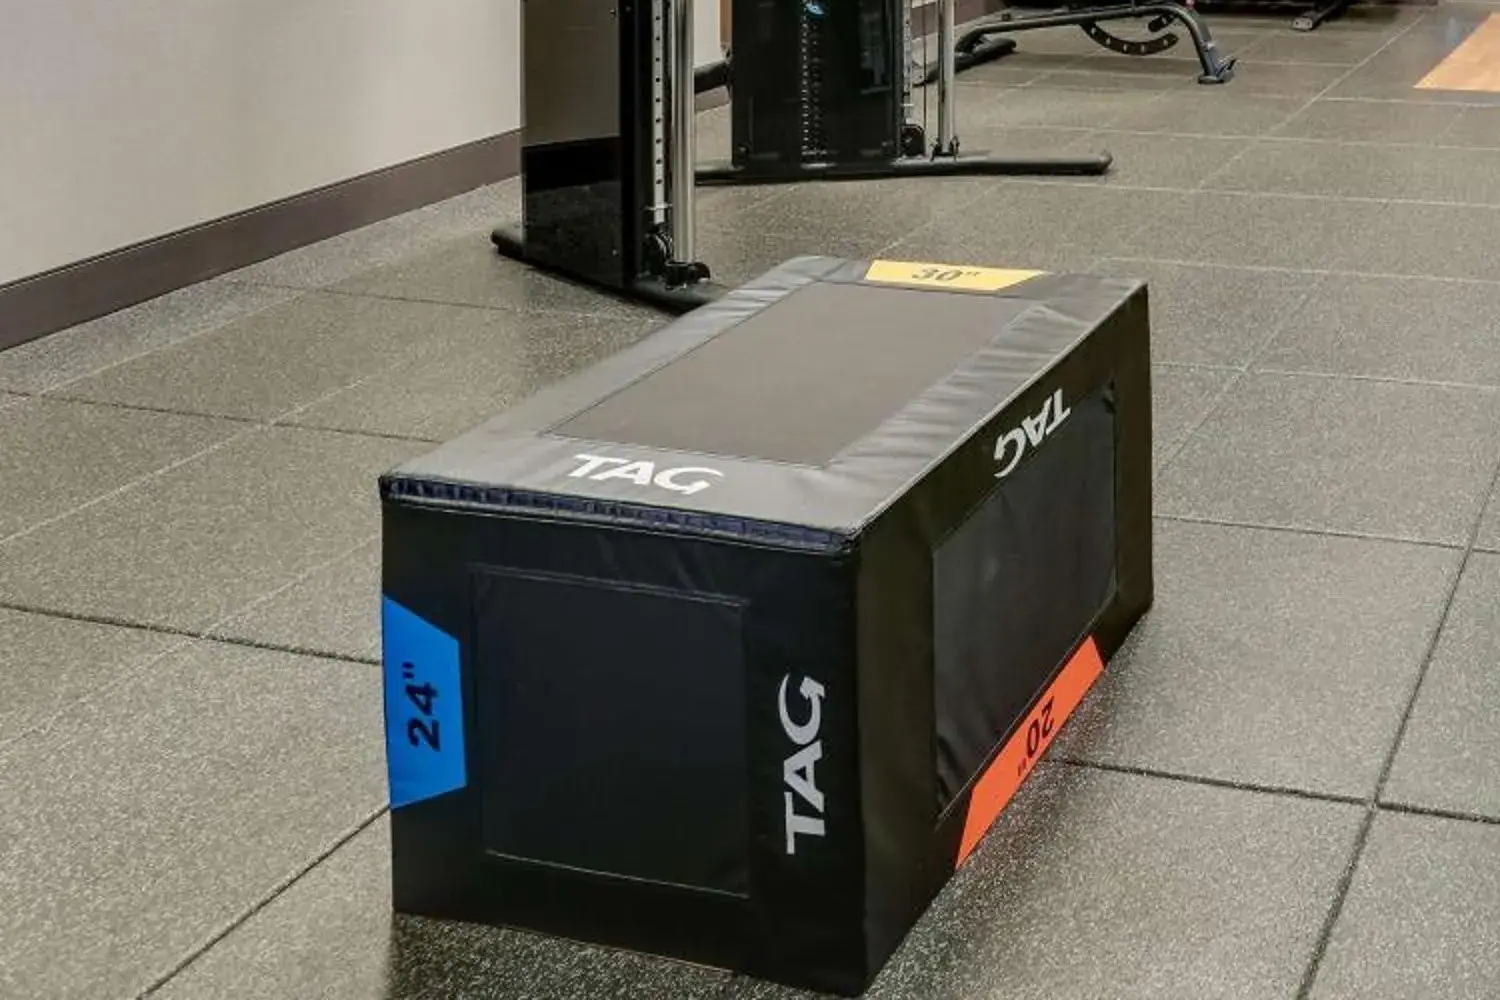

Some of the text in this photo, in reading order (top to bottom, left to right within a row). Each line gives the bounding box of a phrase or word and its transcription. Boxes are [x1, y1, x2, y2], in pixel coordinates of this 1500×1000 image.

[911, 267, 982, 282] 30"
[566, 454, 725, 495] TAG
[993, 388, 1071, 479] TAG
[402, 660, 442, 752] 24"
[1016, 697, 1055, 777] 20"
[777, 672, 827, 855] TAG
